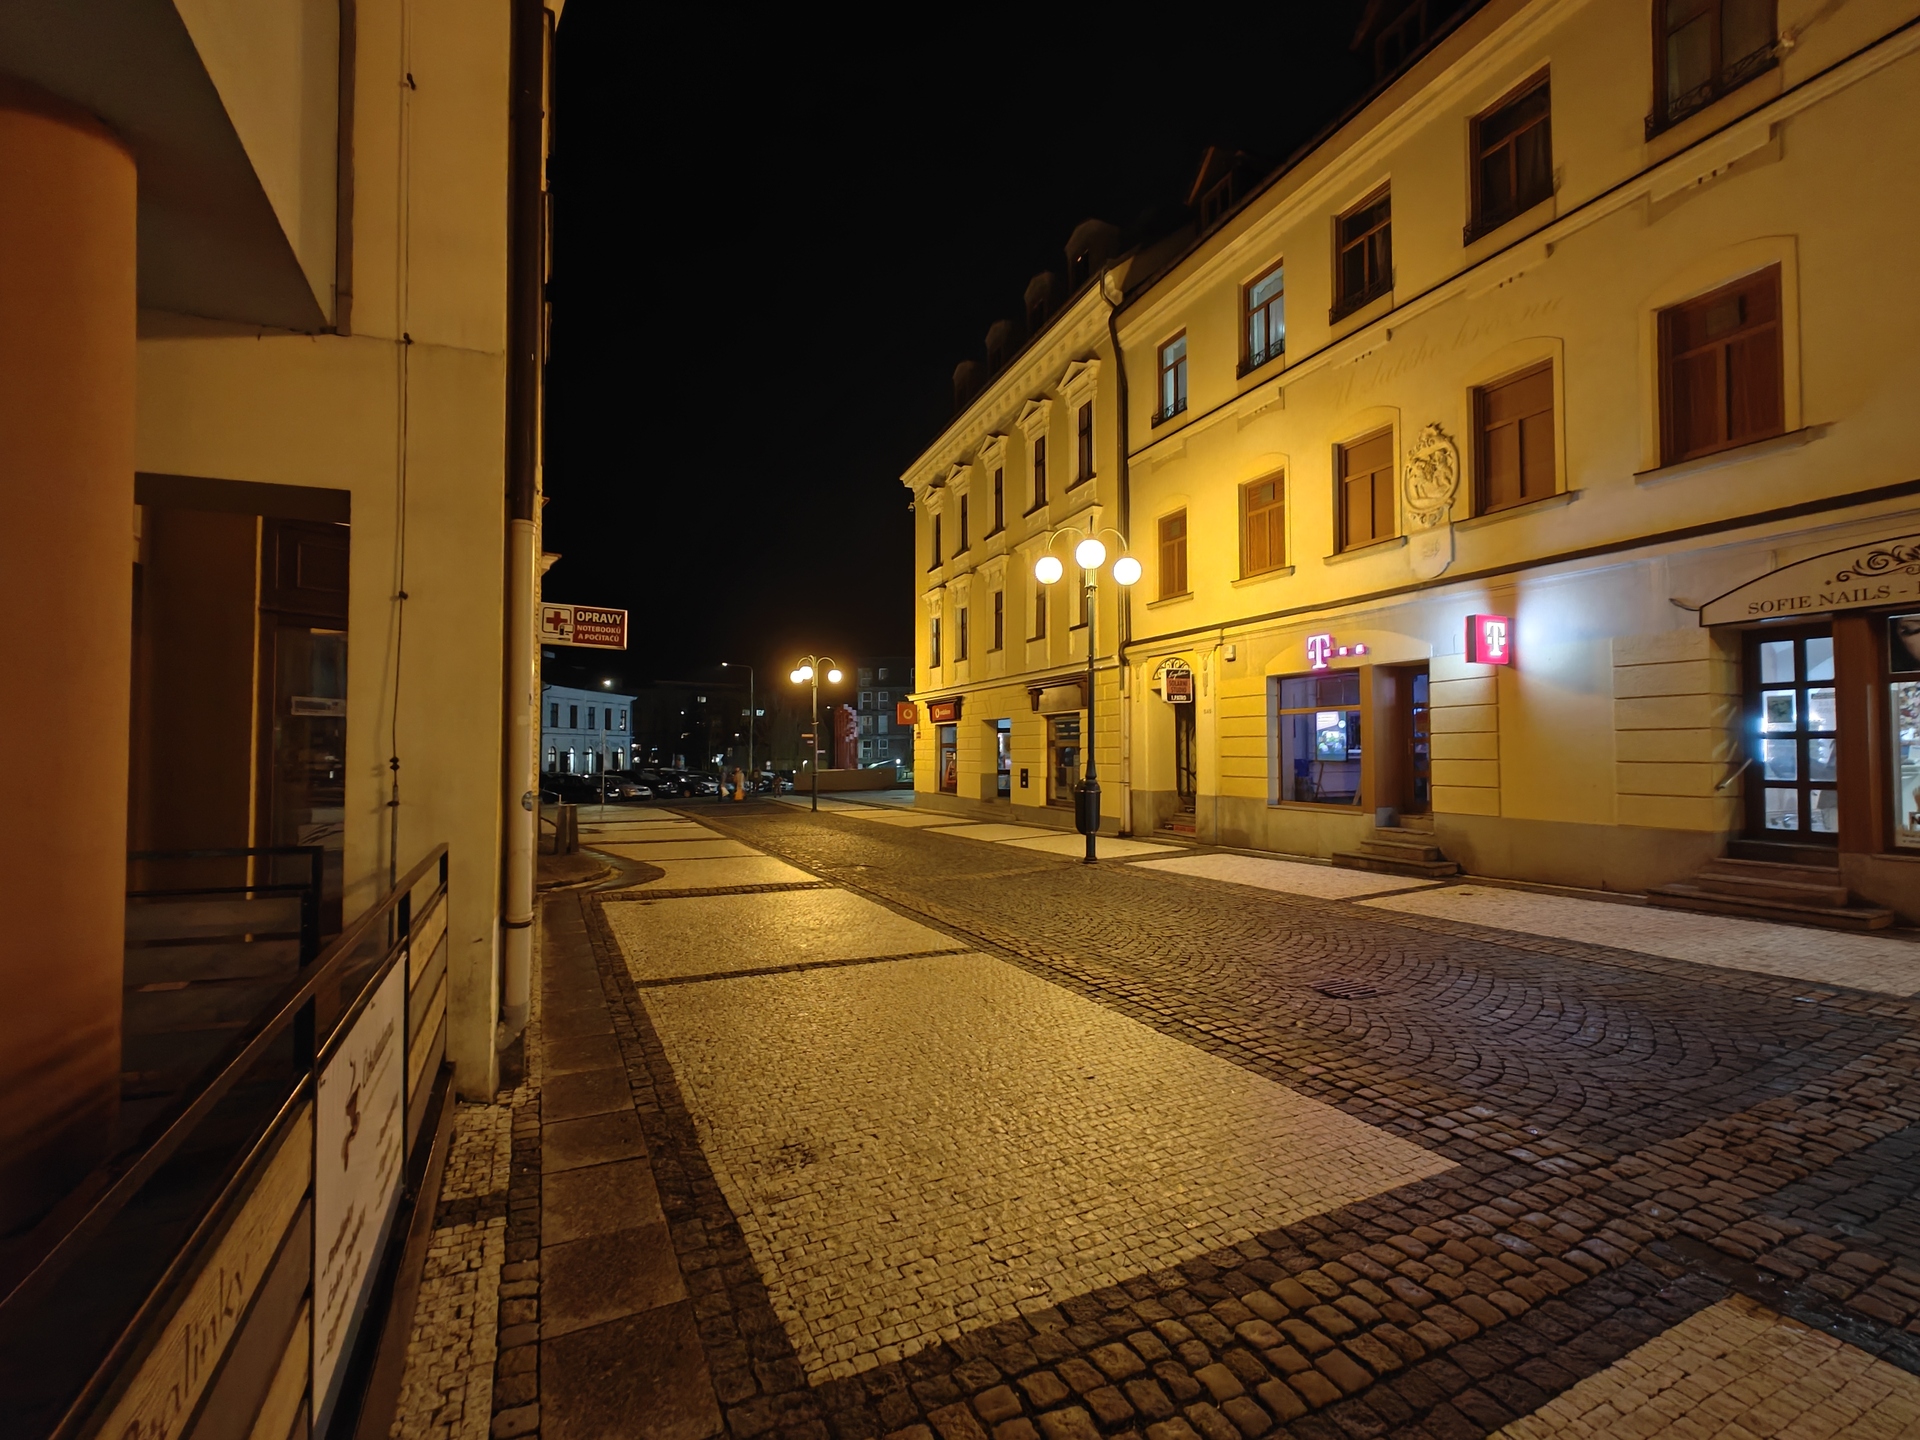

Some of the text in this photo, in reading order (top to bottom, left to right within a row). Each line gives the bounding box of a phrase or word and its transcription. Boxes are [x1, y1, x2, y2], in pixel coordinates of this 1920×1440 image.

[1748, 595, 1812, 615] SOFIE
[1819, 585, 1891, 607] NAILS
[576, 611, 622, 625] OPRAVY
[1486, 621, 1506, 656] T
